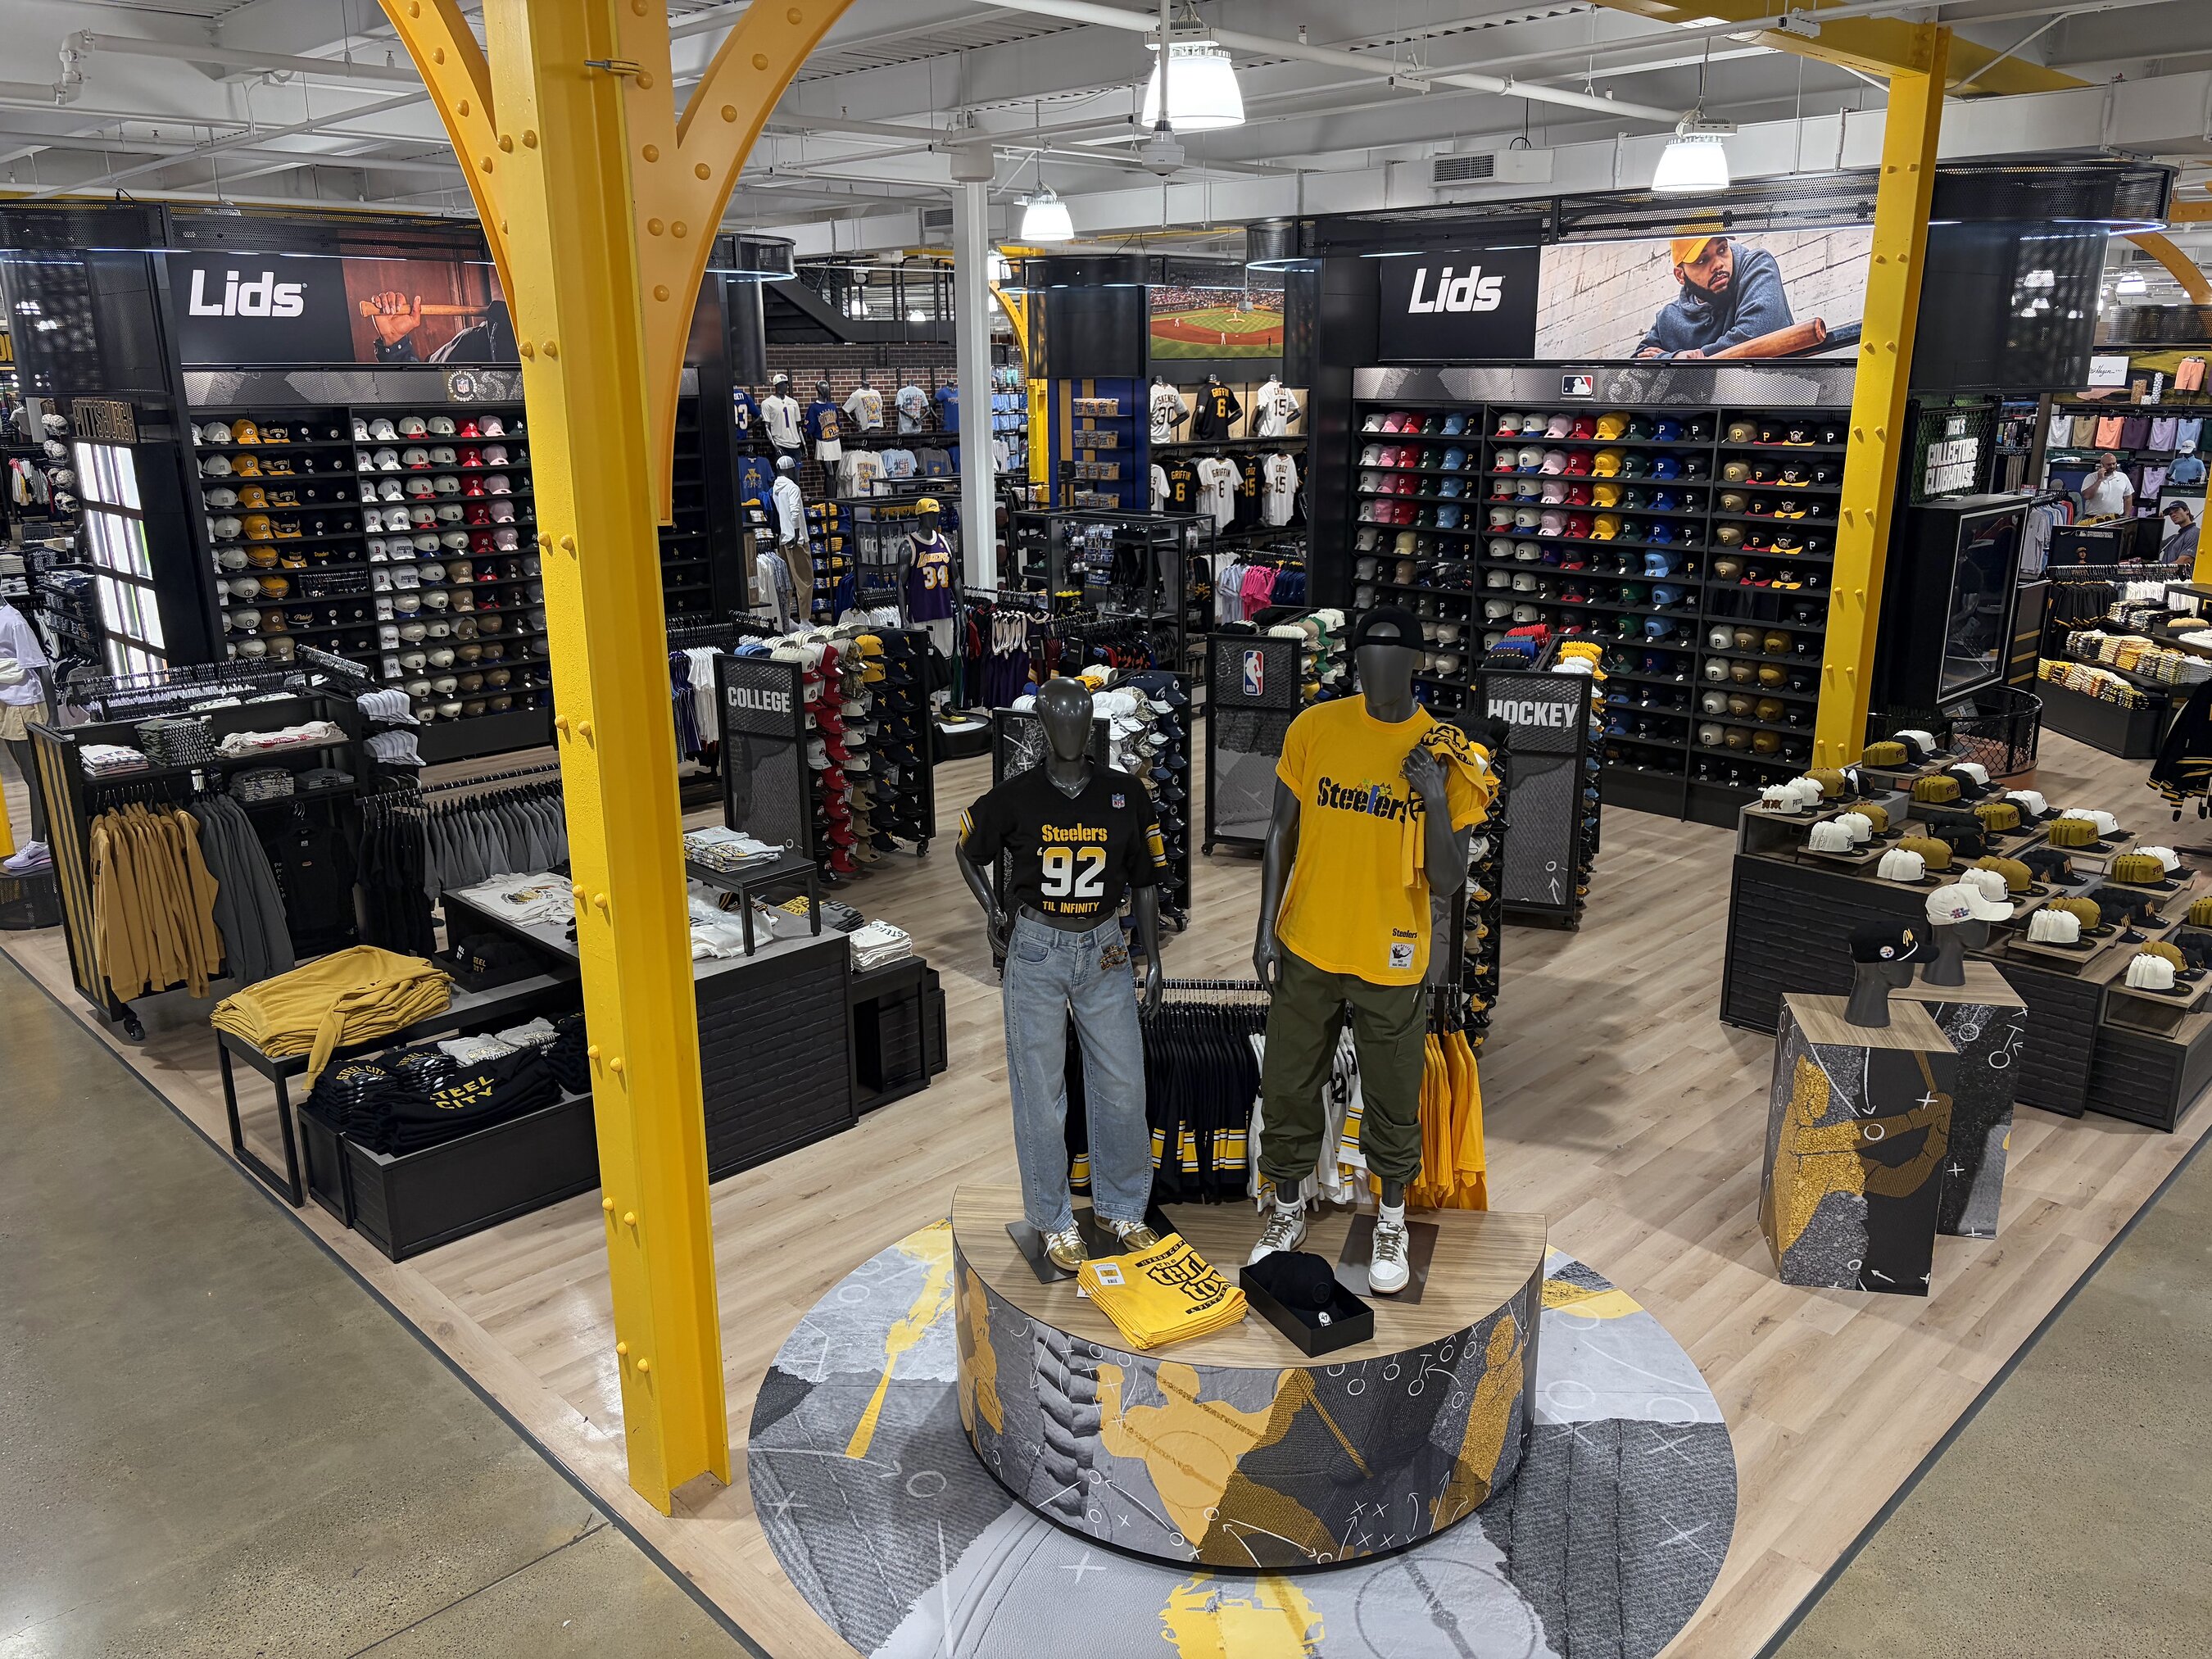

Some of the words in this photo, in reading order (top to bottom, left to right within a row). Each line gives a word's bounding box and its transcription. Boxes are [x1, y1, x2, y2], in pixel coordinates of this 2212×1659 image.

[189, 269, 304, 317] Lids
[1408, 265, 1504, 313] Lids
[1156, 406, 1176, 425] 30
[1217, 398, 1226, 418] 6
[1274, 398, 1287, 417] 15
[71, 399, 137, 442] PITTSBURGH
[782, 407, 790, 428] 1
[1927, 437, 1979, 468] COLLECTORS
[1171, 469, 1191, 482] GRIFFIN
[1212, 468, 1231, 478] GRIFFIN
[1924, 461, 1976, 495] CLUBHOUSE
[1175, 482, 1186, 502] 6
[1218, 480, 1225, 498] 6
[1244, 478, 1256, 498] 15
[1275, 475, 1286, 494] 15
[917, 551, 950, 569] LAKERS
[922, 564, 949, 590] 34
[1245, 685, 1256, 693] NBA
[727, 686, 791, 714] COLLEGE
[1487, 699, 1579, 728] HOCKEY
[1041, 823, 1108, 842] Steelers
[1042, 900, 1056, 911] TIL
[1060, 901, 1099, 913] INFINITY
[1392, 927, 1418, 939] Steelers
[334, 1065, 359, 1081] STEEL
[367, 1065, 387, 1077] CITY
[435, 1086, 493, 1109] CITY
[1140, 1251, 1168, 1265] MYRON
[1156, 1258, 1176, 1268] The
